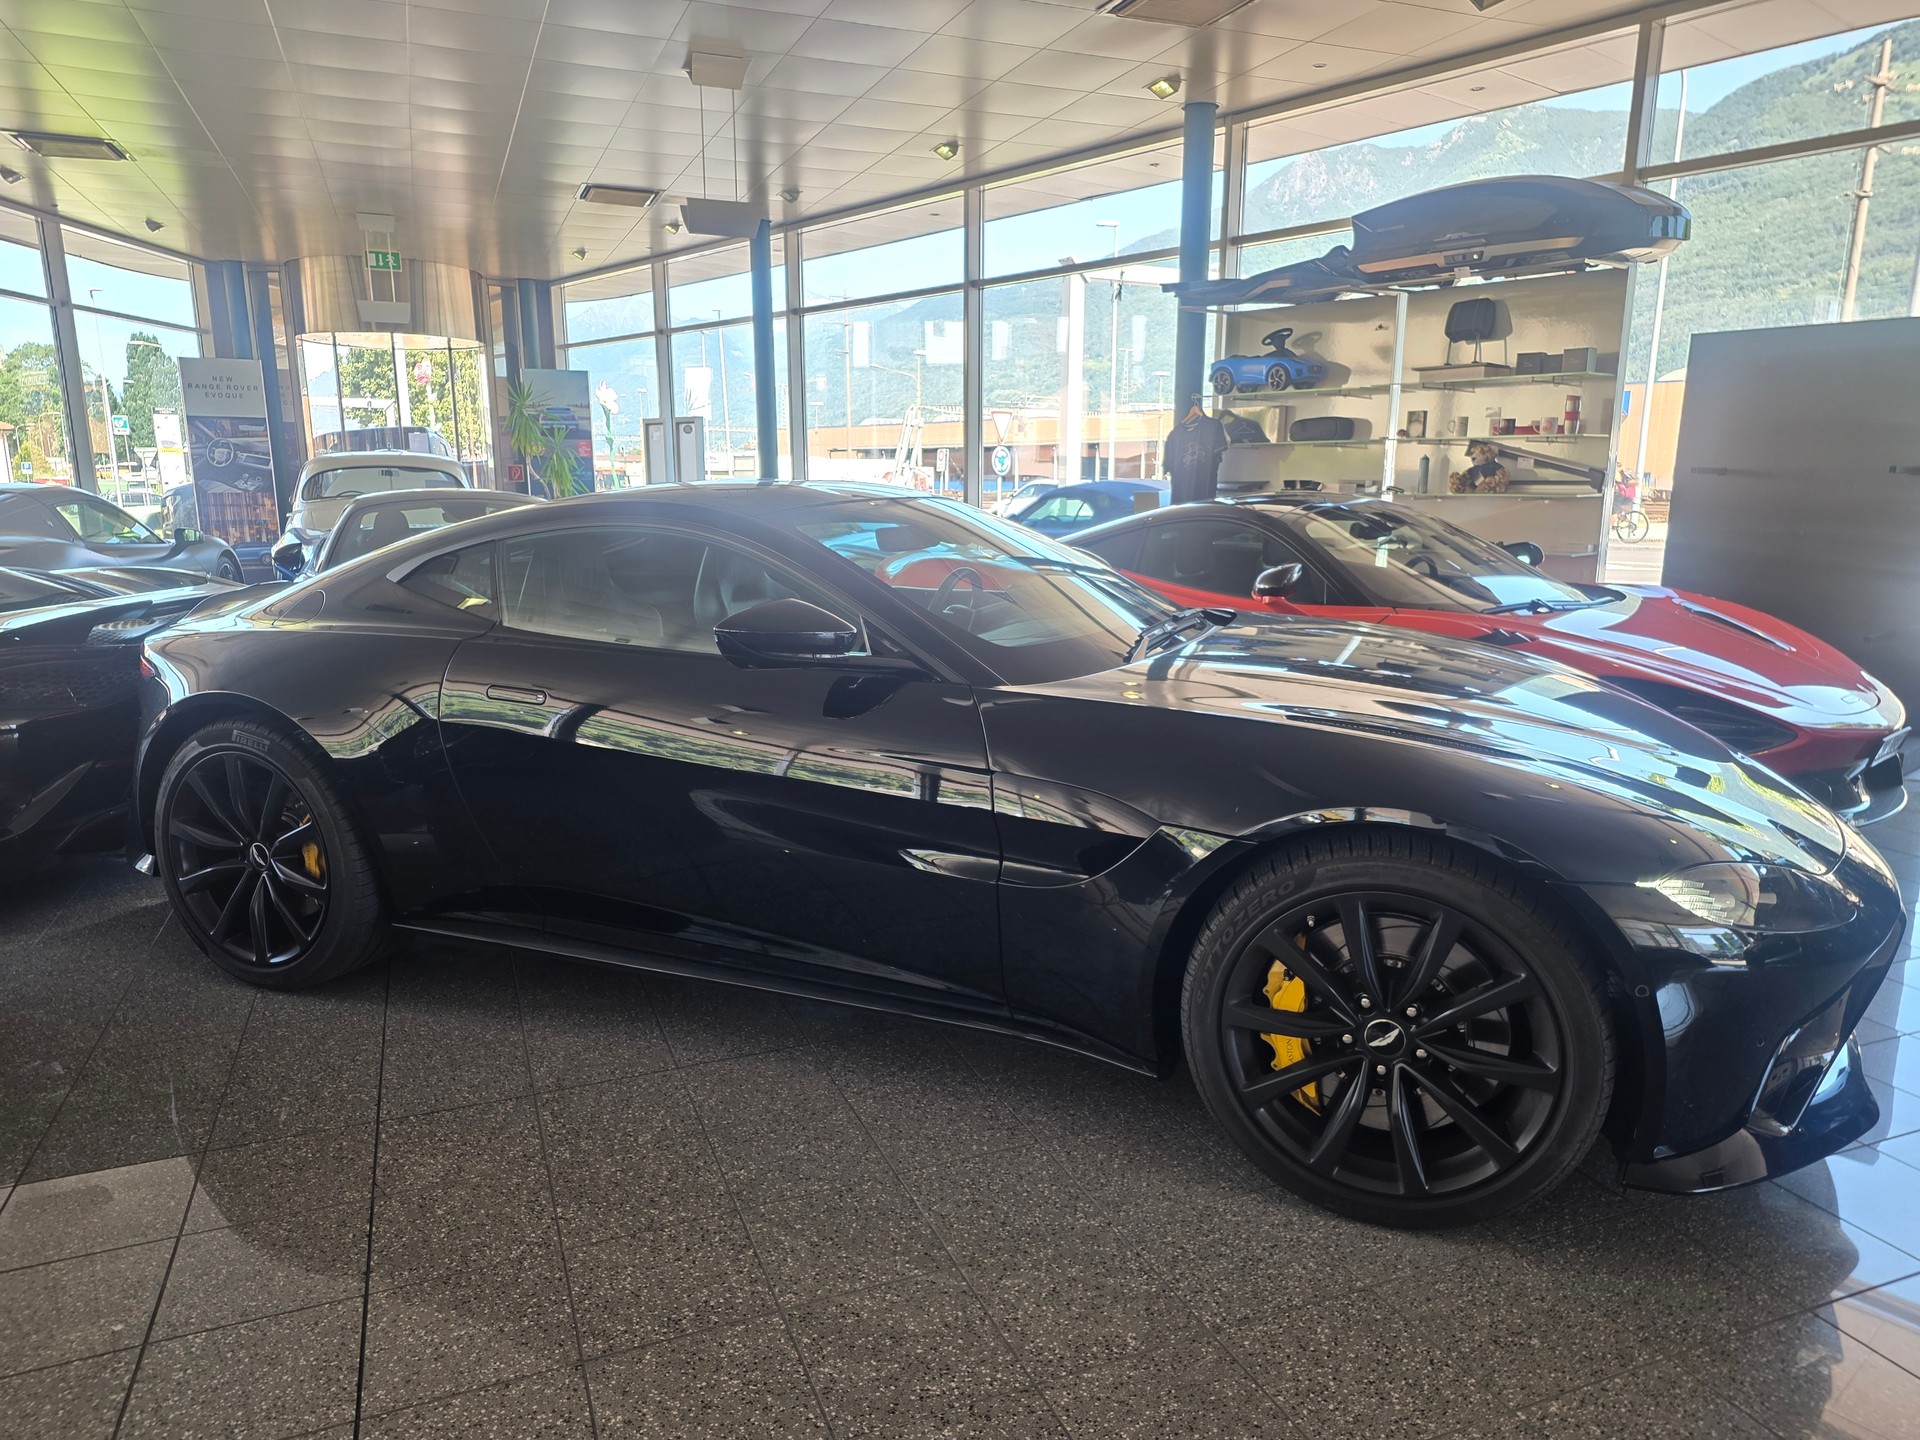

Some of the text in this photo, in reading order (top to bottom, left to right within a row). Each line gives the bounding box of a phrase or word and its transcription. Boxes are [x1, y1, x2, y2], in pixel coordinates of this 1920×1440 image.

[212, 375, 233, 383] NEW
[187, 383, 221, 391] RANGE
[204, 392, 244, 400] EVOQUE
[231, 729, 271, 752] PIRELLI
[1195, 880, 1296, 1008] SOTTOZERO
[1286, 1038, 1294, 1063] ASTON
